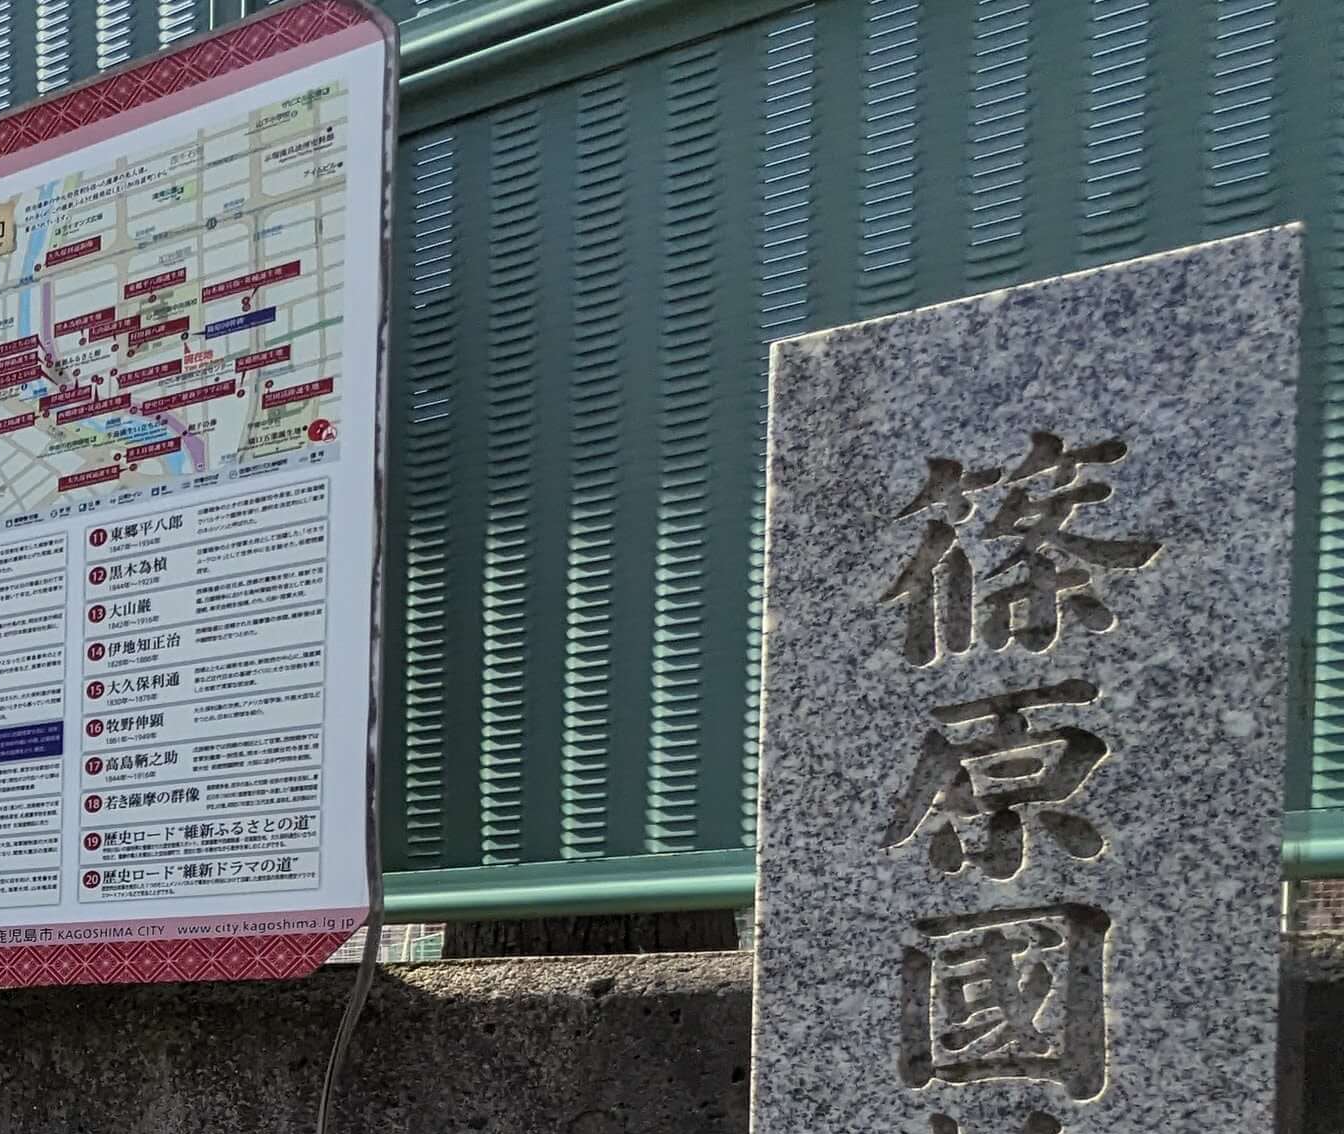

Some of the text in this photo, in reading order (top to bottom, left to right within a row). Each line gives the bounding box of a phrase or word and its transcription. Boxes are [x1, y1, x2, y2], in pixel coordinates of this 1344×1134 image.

[106, 670, 180, 696] 大久保利通
[57, 926, 134, 940] KAGOSHIMA
[137, 925, 165, 938] CITY
